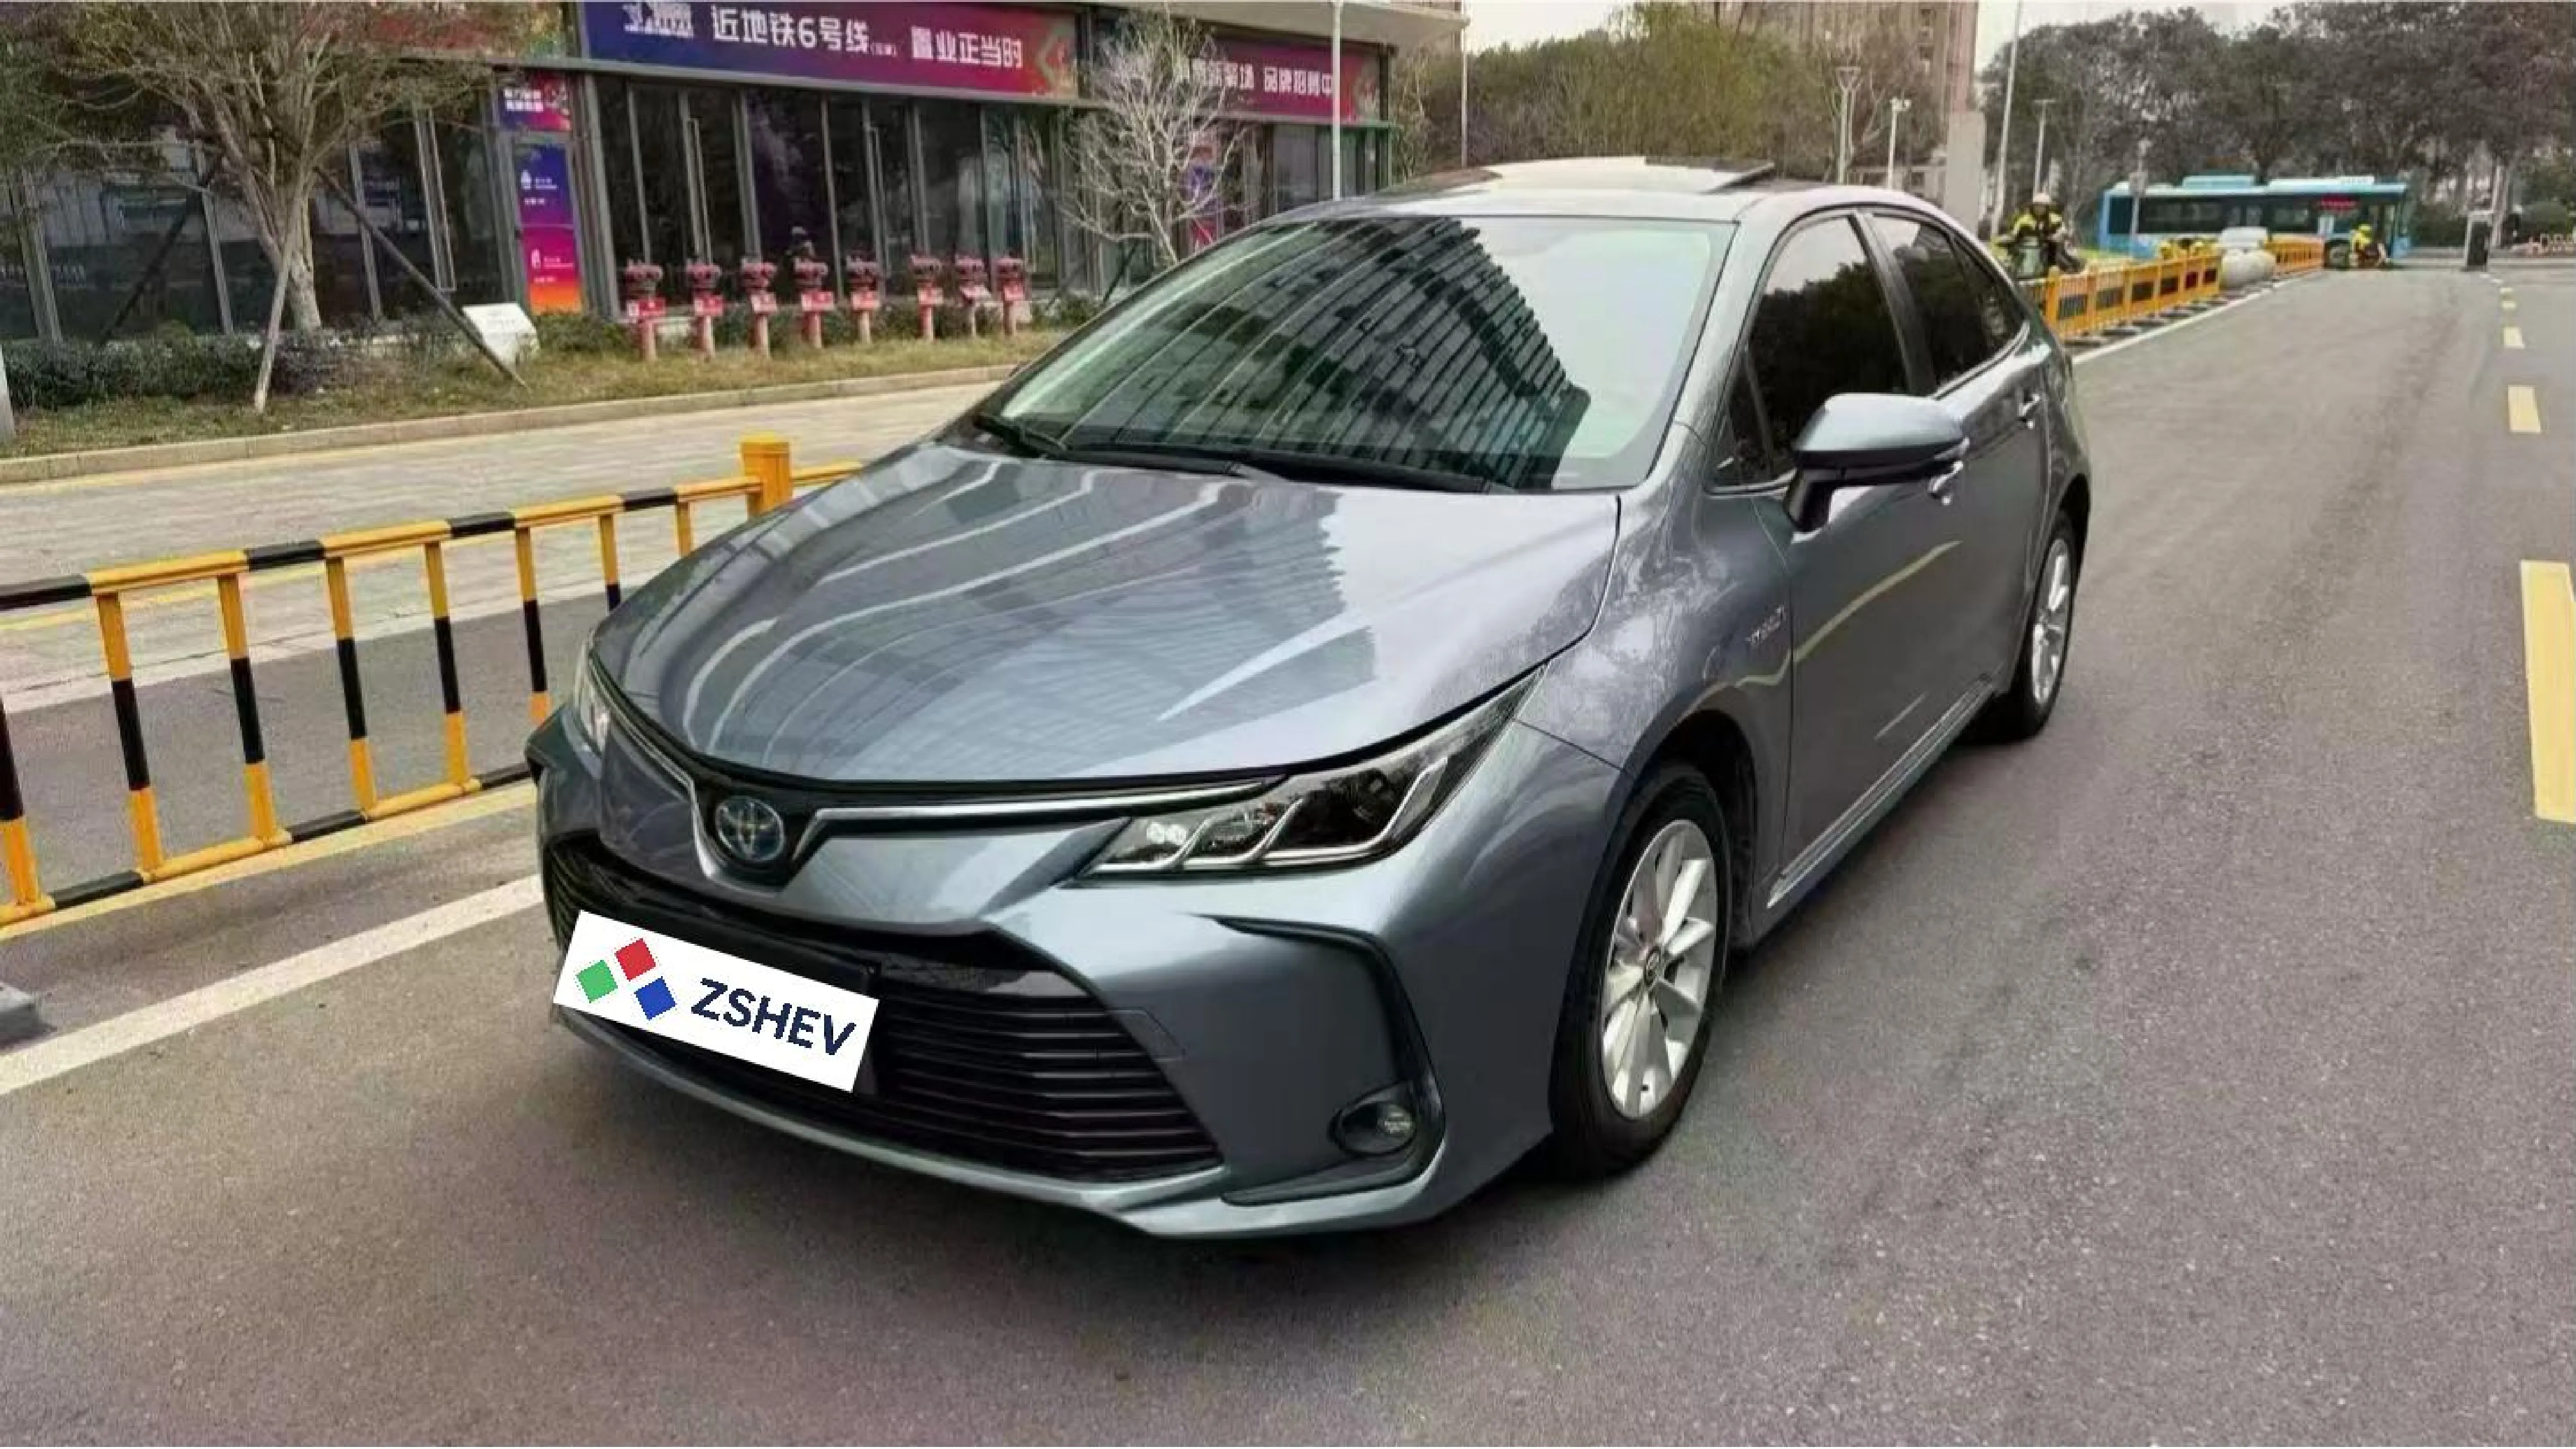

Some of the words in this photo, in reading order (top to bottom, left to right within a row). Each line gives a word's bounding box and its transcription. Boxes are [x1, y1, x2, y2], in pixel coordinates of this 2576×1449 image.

[710, 5, 869, 53] 近地铁6号线
